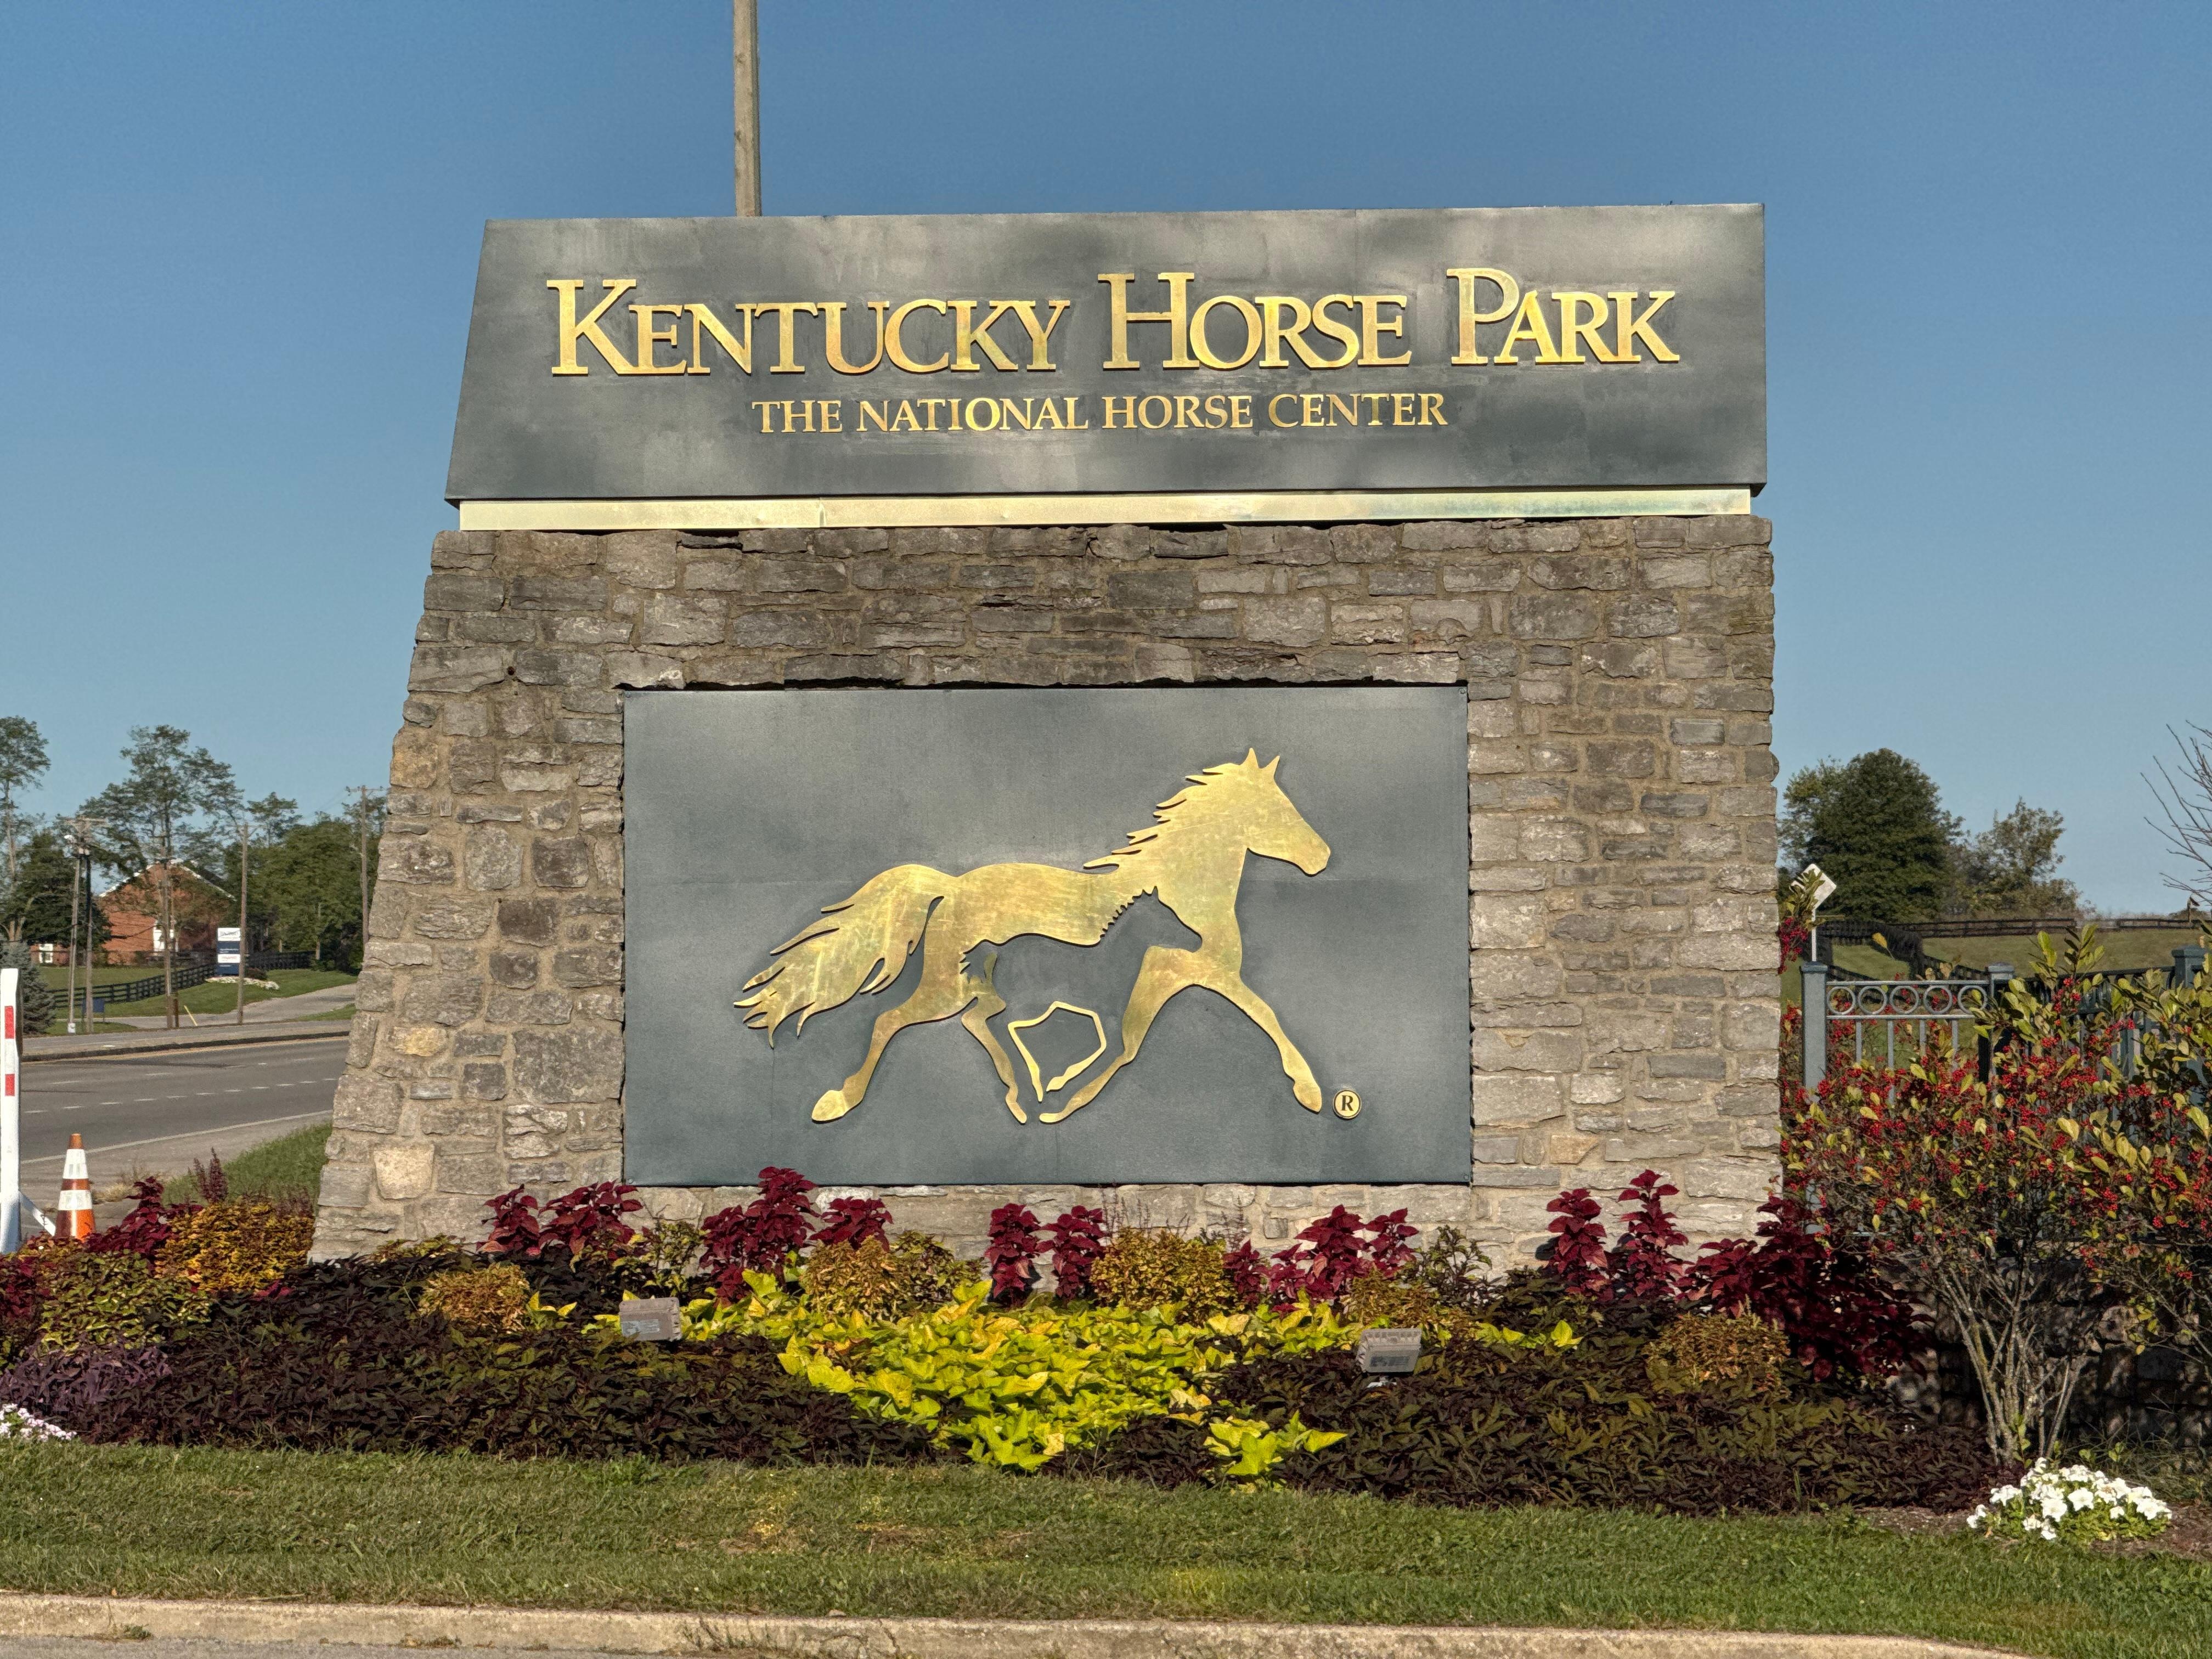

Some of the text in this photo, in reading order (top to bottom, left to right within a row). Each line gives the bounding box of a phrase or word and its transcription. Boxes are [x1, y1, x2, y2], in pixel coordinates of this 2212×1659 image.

[546, 267, 1680, 376] KENTUCKY HORSE PARK
[752, 392, 1447, 433] THE NATIONAL HORSE CENTER
